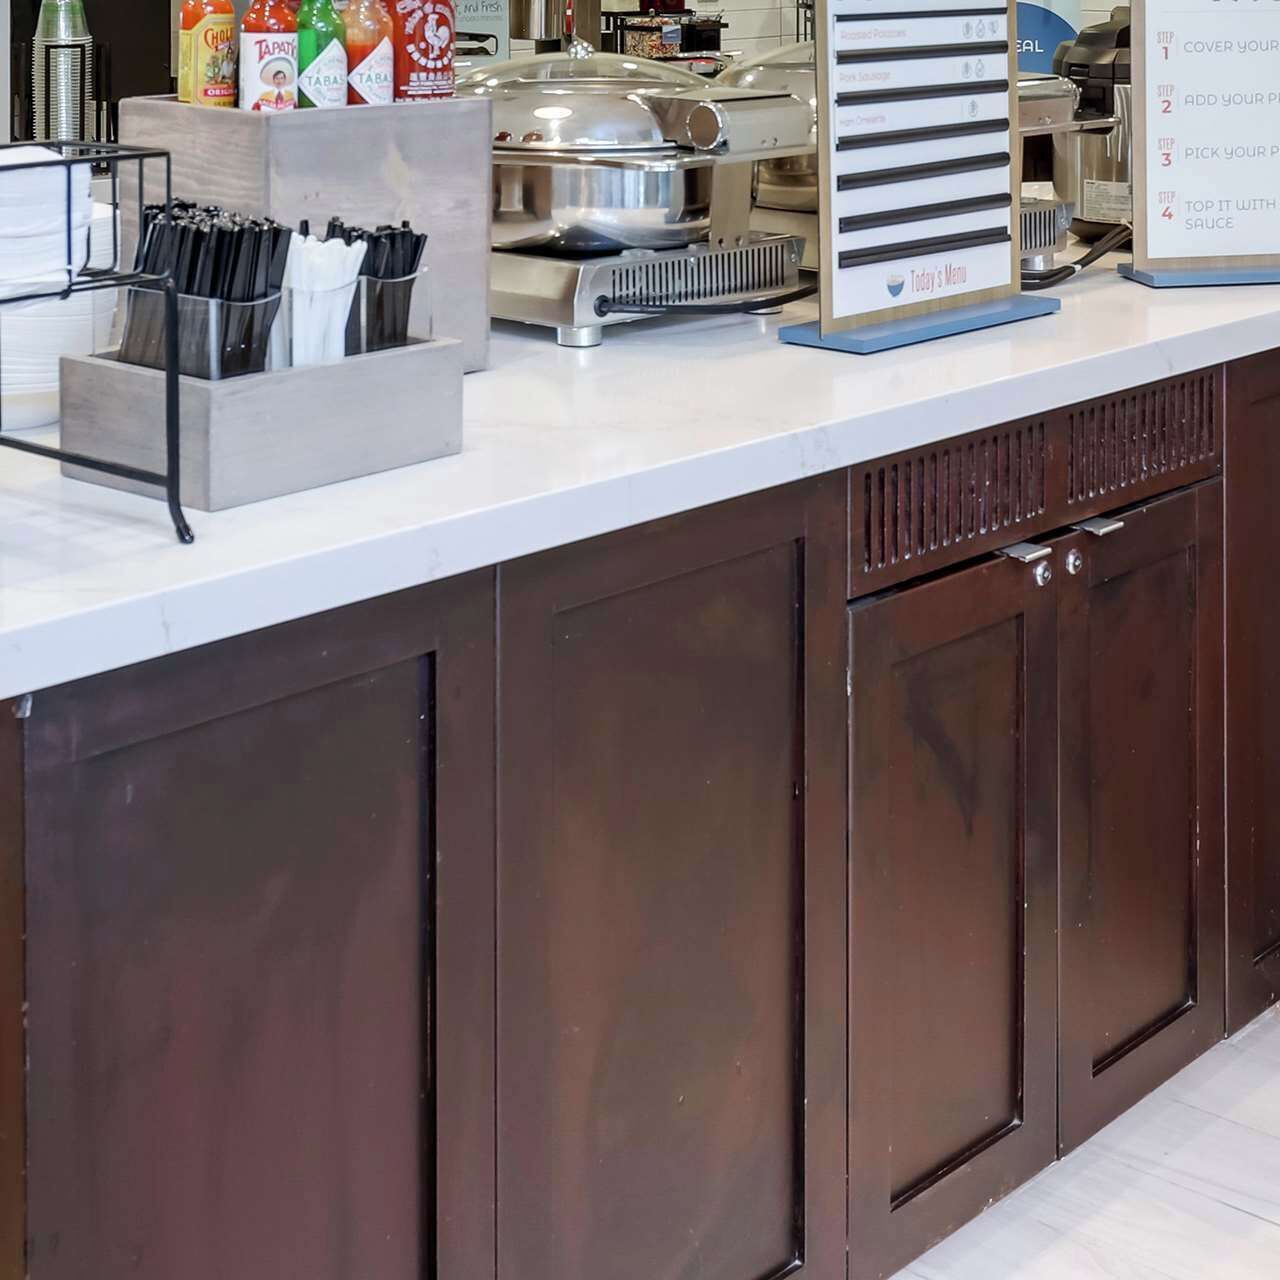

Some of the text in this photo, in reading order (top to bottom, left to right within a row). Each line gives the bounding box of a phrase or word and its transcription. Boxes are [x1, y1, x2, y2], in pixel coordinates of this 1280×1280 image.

[1157, 31, 1174, 44] STEP
[1162, 46, 1169, 60] 1
[1183, 39, 1233, 53] COVER
[1237, 39, 1280, 53] YOUR
[357, 72, 389, 84] TABA
[1157, 84, 1174, 97] STEP
[1161, 99, 1172, 114] 2
[1184, 94, 1218, 107] ADD
[1221, 93, 1264, 107] YOUR
[1158, 137, 1175, 150] STEP
[1184, 147, 1220, 160] PICK
[1224, 145, 1266, 160] YOUR
[1161, 153, 1172, 167] 3
[1158, 191, 1176, 204] STEP
[1185, 200, 1215, 213] TOP
[1218, 199, 1233, 212] IT
[1236, 198, 1276, 211] WITH
[1161, 206, 1173, 220] 4
[1185, 216, 1234, 231] SAUCE
[911, 264, 967, 294] Today's Menu
